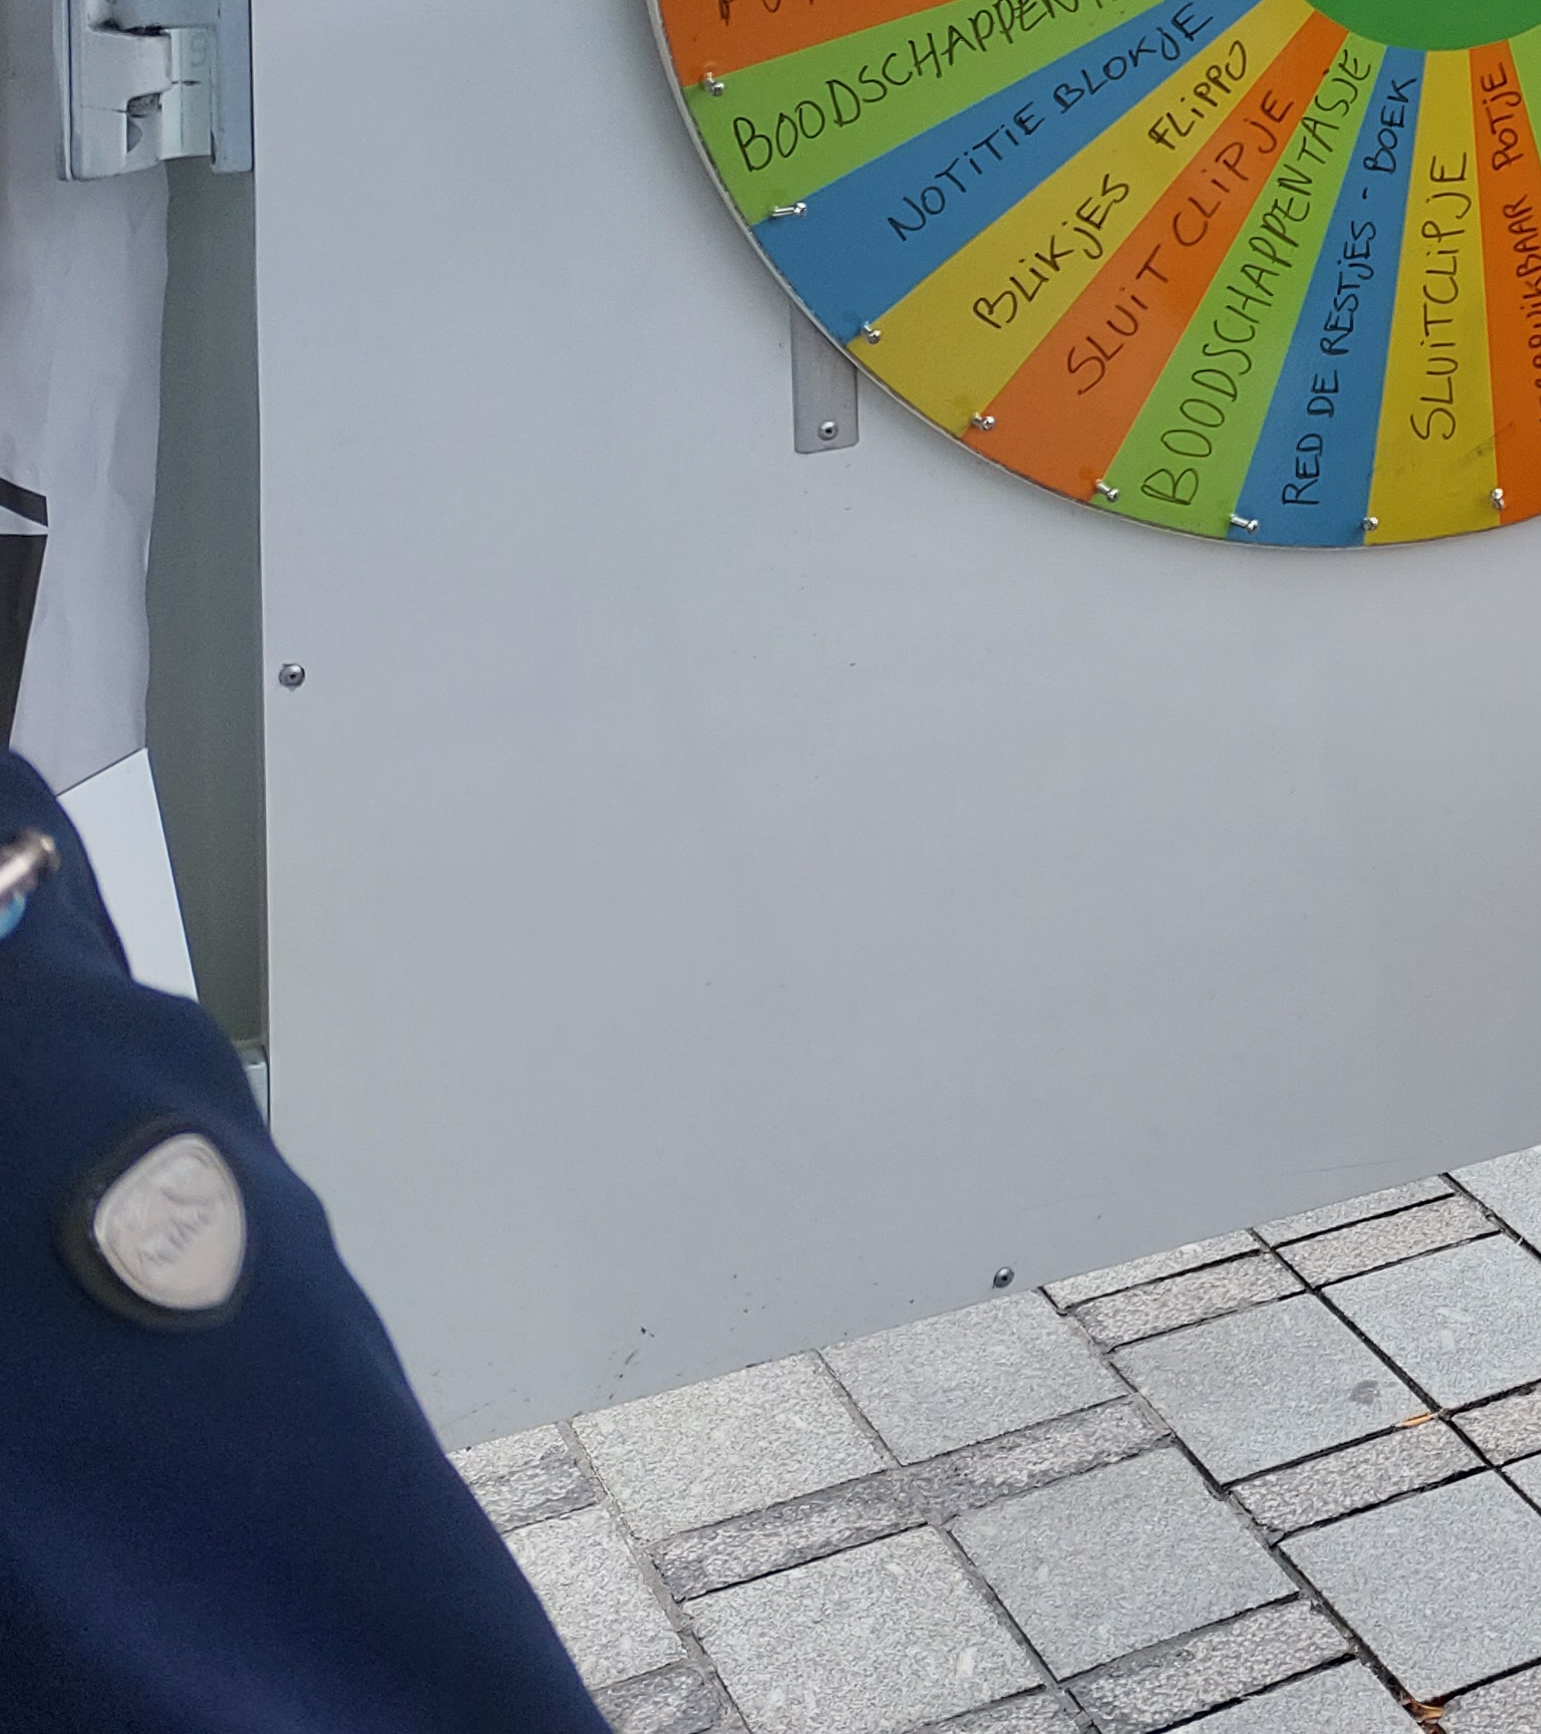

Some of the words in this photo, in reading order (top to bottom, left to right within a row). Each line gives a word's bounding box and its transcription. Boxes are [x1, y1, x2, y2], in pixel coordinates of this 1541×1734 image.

[1280, 432, 1325, 507] RED
[1305, 368, 1341, 419] DE
[1362, 76, 1418, 176] BOEK
